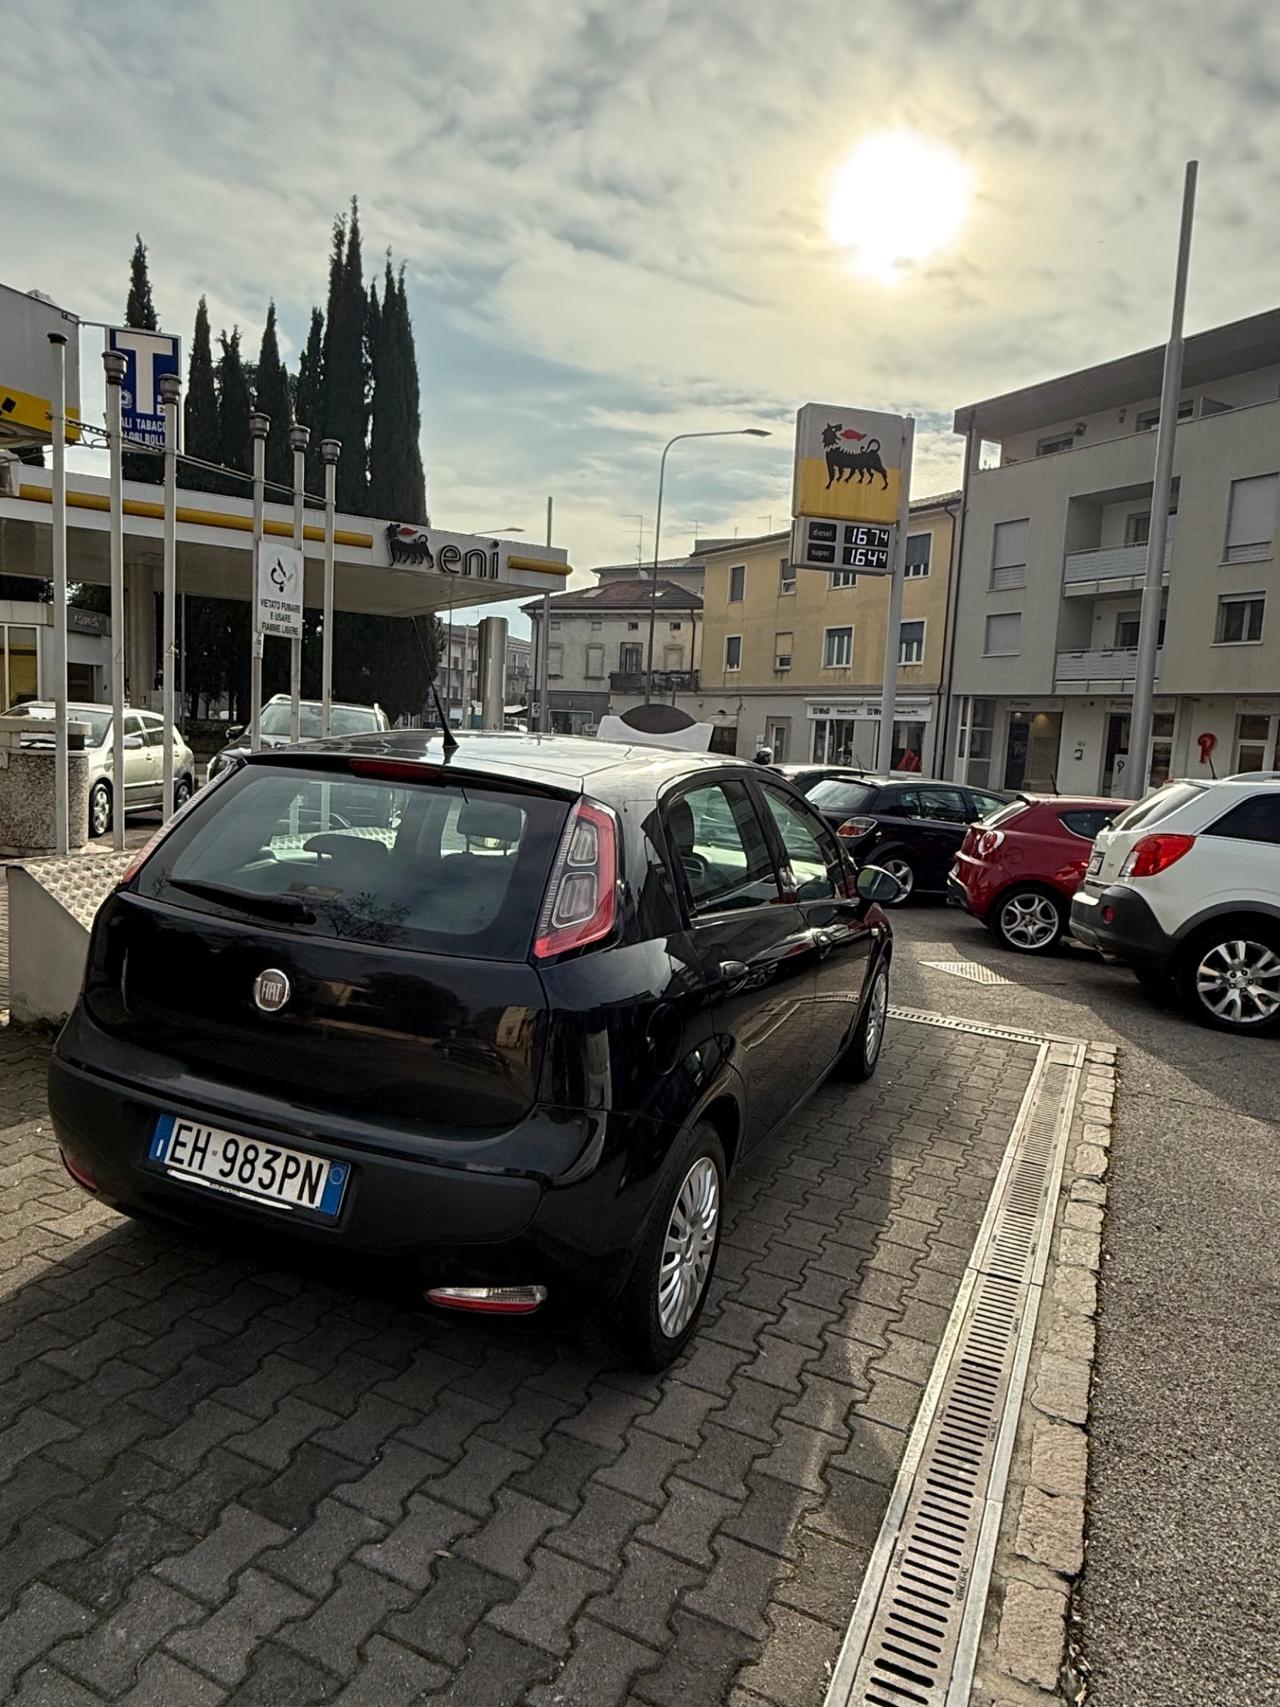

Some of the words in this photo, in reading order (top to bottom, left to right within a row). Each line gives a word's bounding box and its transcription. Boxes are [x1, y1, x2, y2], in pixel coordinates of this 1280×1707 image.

[439, 540, 500, 579] eni
[270, 611, 274, 620] E
[275, 612, 291, 623] USARE
[261, 980, 283, 1002] FIAT
